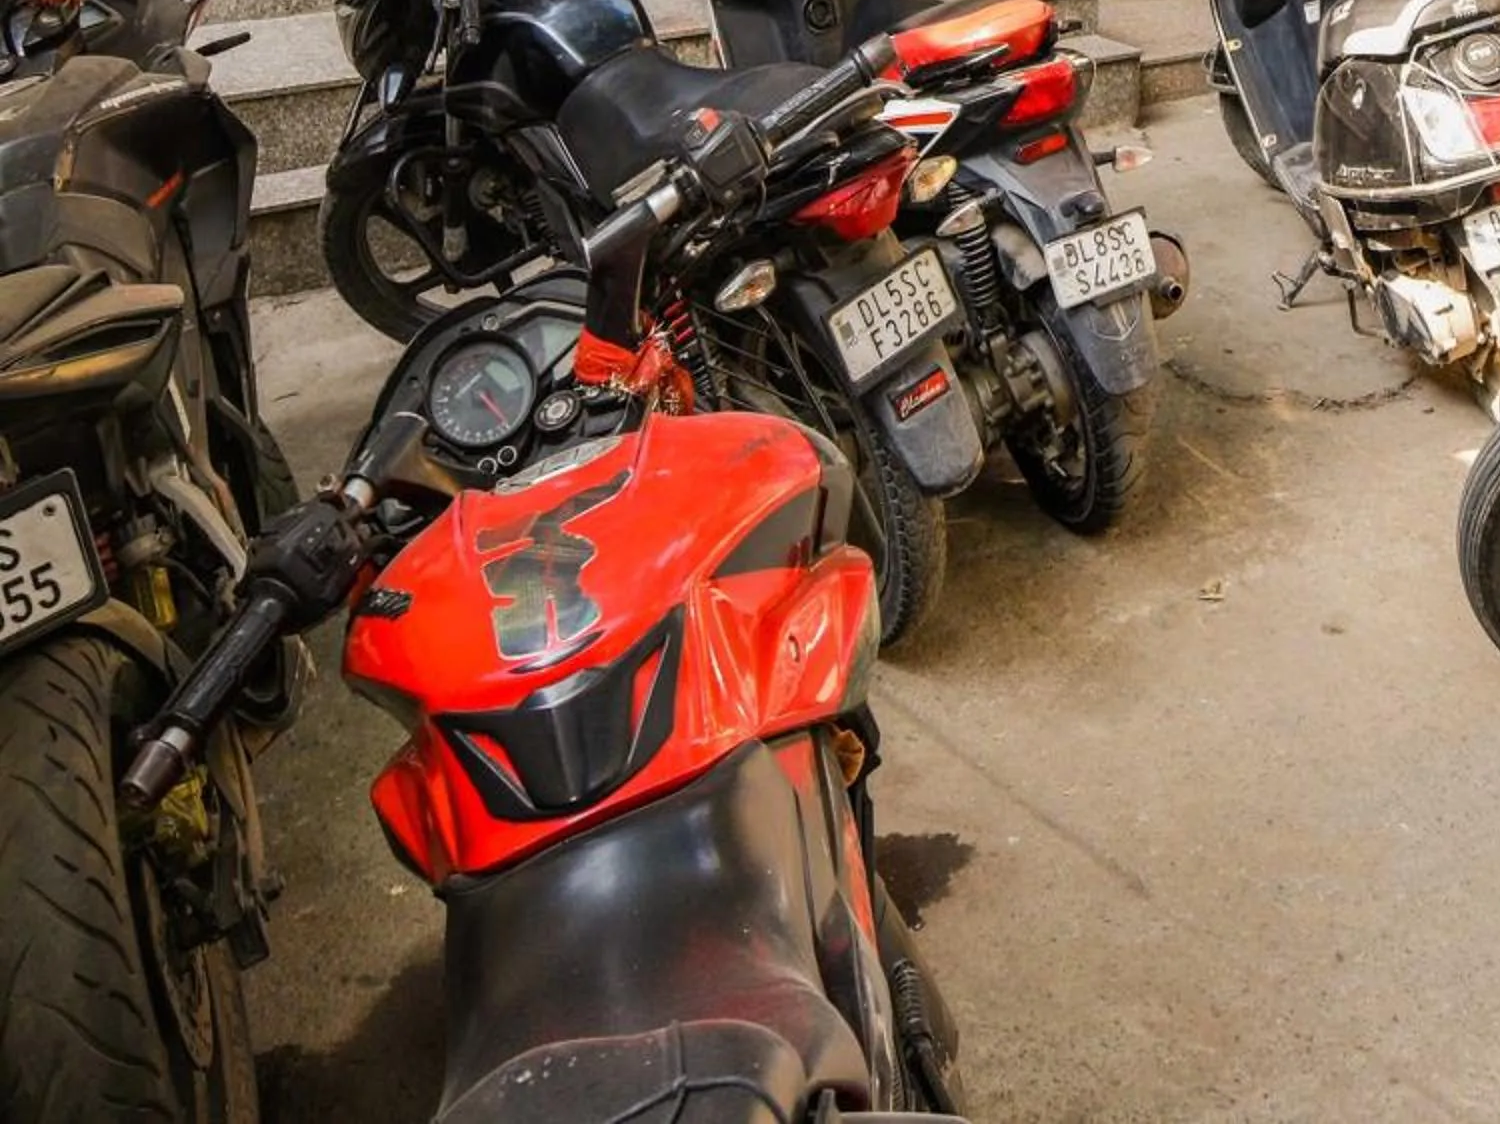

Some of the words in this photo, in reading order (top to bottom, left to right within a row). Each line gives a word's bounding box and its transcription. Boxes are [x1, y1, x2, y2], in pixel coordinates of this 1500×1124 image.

[1063, 222, 1135, 268] DL8SC
[857, 261, 931, 327] DL5SC
[870, 291, 943, 360] F3286
[0, 562, 61, 633] 55
